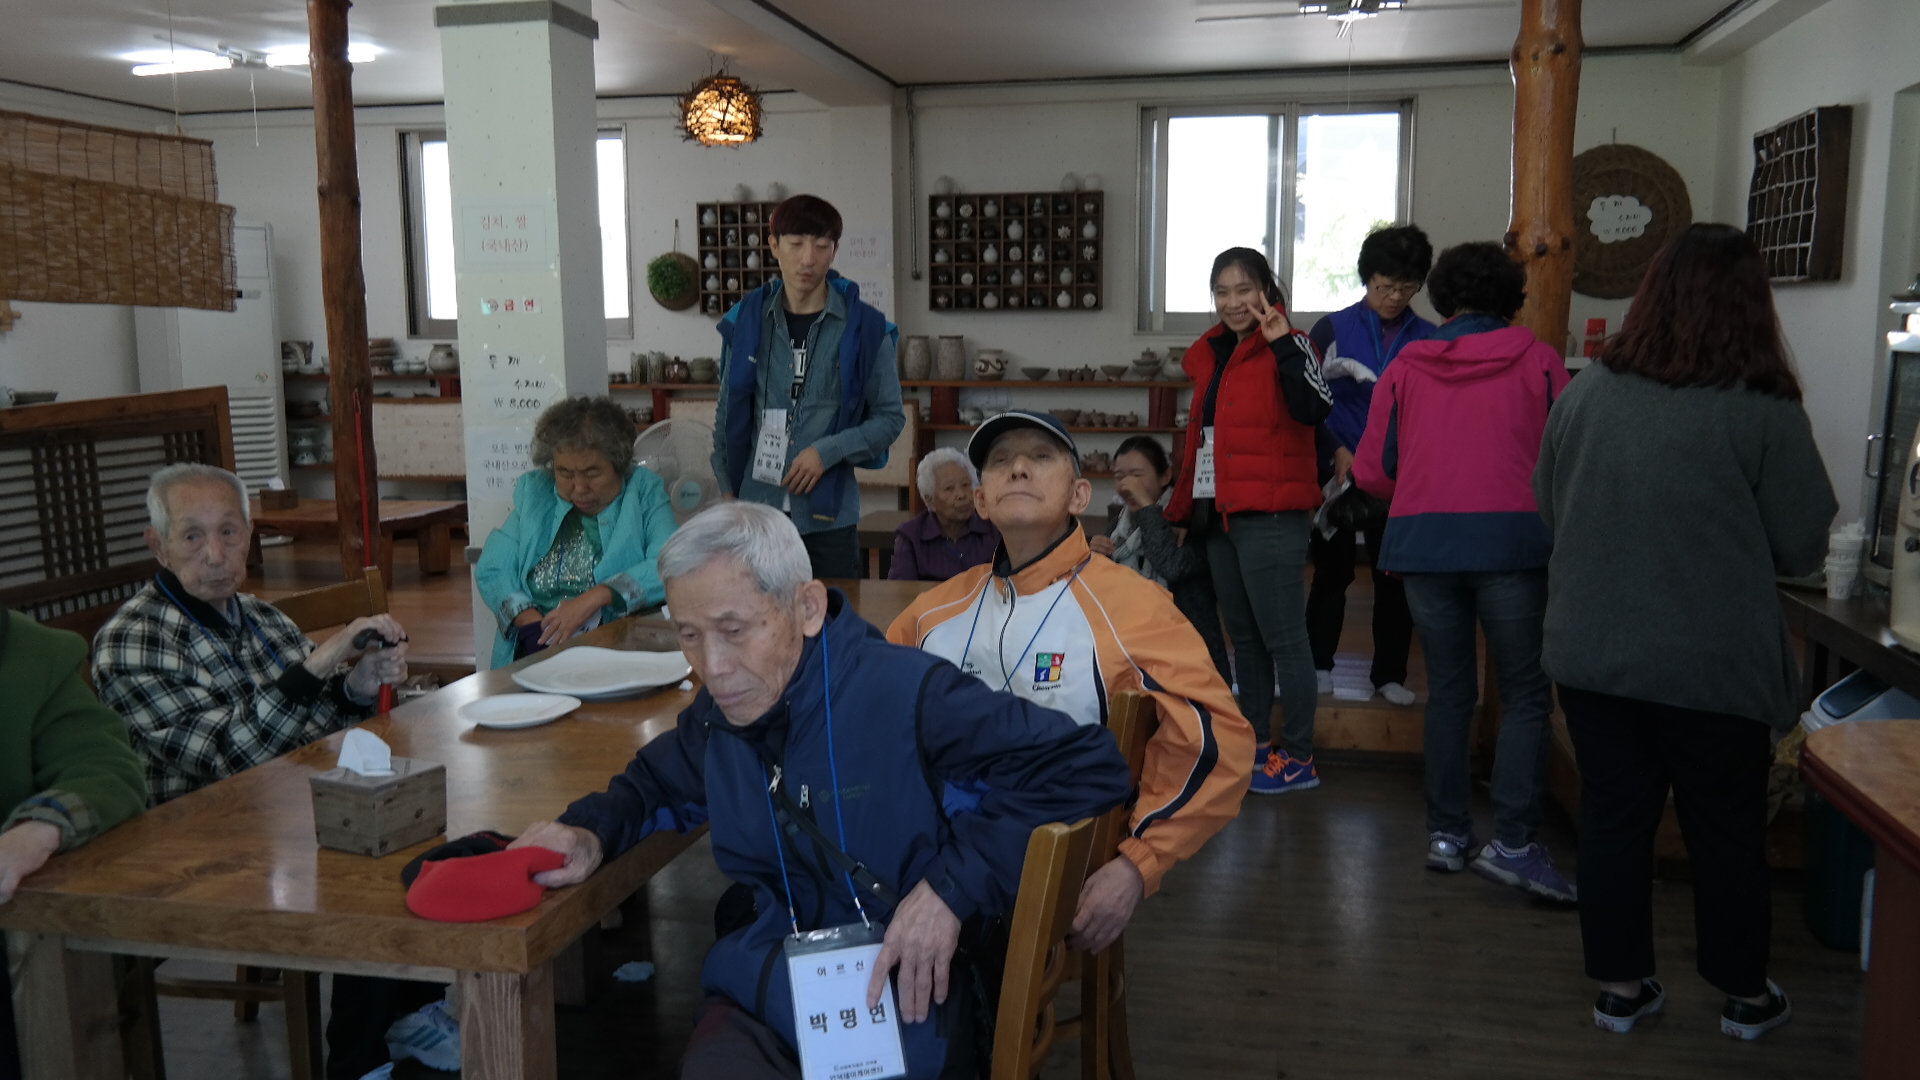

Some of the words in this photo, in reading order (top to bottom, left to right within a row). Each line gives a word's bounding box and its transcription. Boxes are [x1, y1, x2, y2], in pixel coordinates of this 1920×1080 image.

[482, 215, 508, 230] 김치,
[516, 215, 527, 230] 쌀
[481, 238, 529, 253] (국내산)
[509, 398, 541, 409] 8,000
